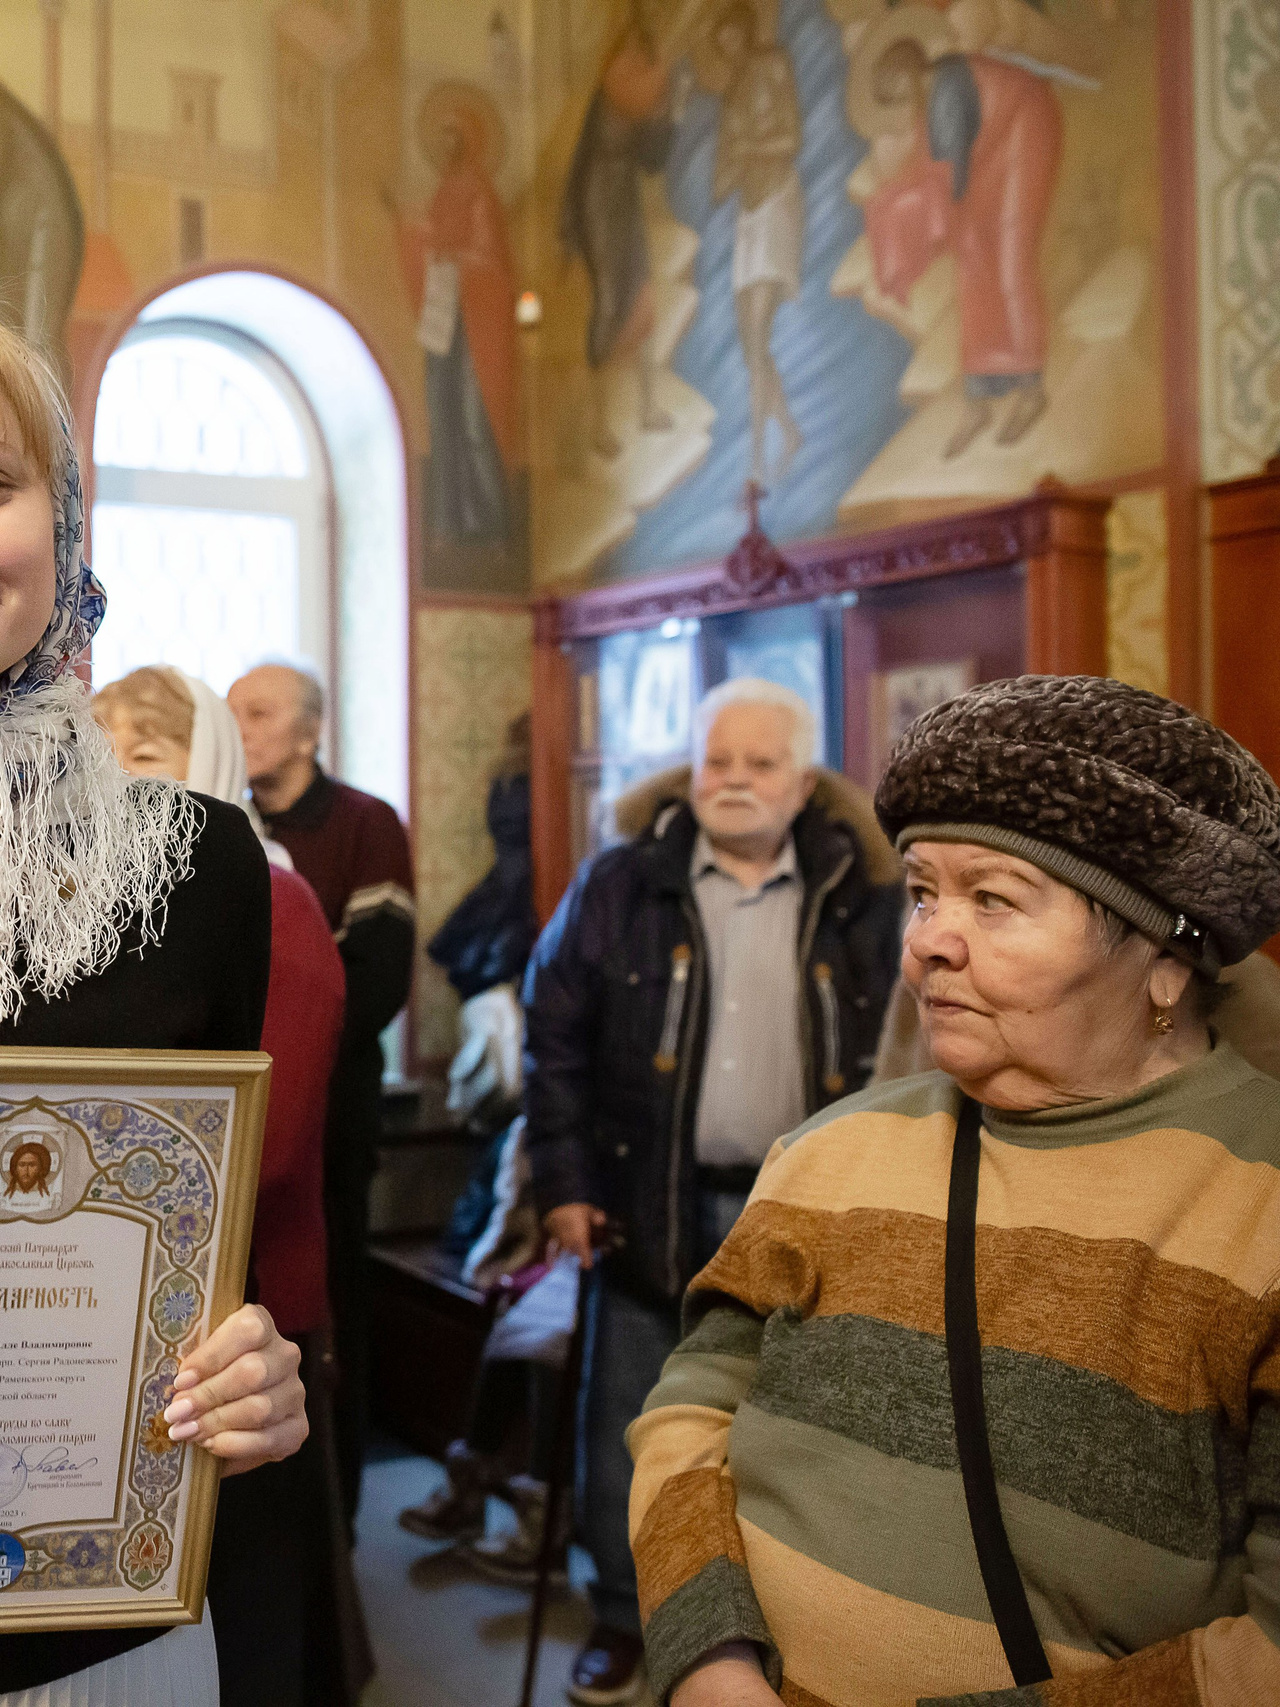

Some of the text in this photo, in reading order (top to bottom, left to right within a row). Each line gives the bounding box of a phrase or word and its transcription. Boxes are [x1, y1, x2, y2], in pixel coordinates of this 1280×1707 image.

[24, 1242, 79, 1256] Патриархат
[56, 1257, 95, 1272] Церковь
[21, 1341, 93, 1350] Владимировне
[18, 1358, 51, 1368] Сергия
[53, 1357, 118, 1367] Радонежского
[0, 1375, 52, 1384] Раменского
[54, 1376, 86, 1384] округа
[20, 1392, 58, 1400] области
[44, 1418, 72, 1431] славу
[58, 1433, 97, 1447] епархии
